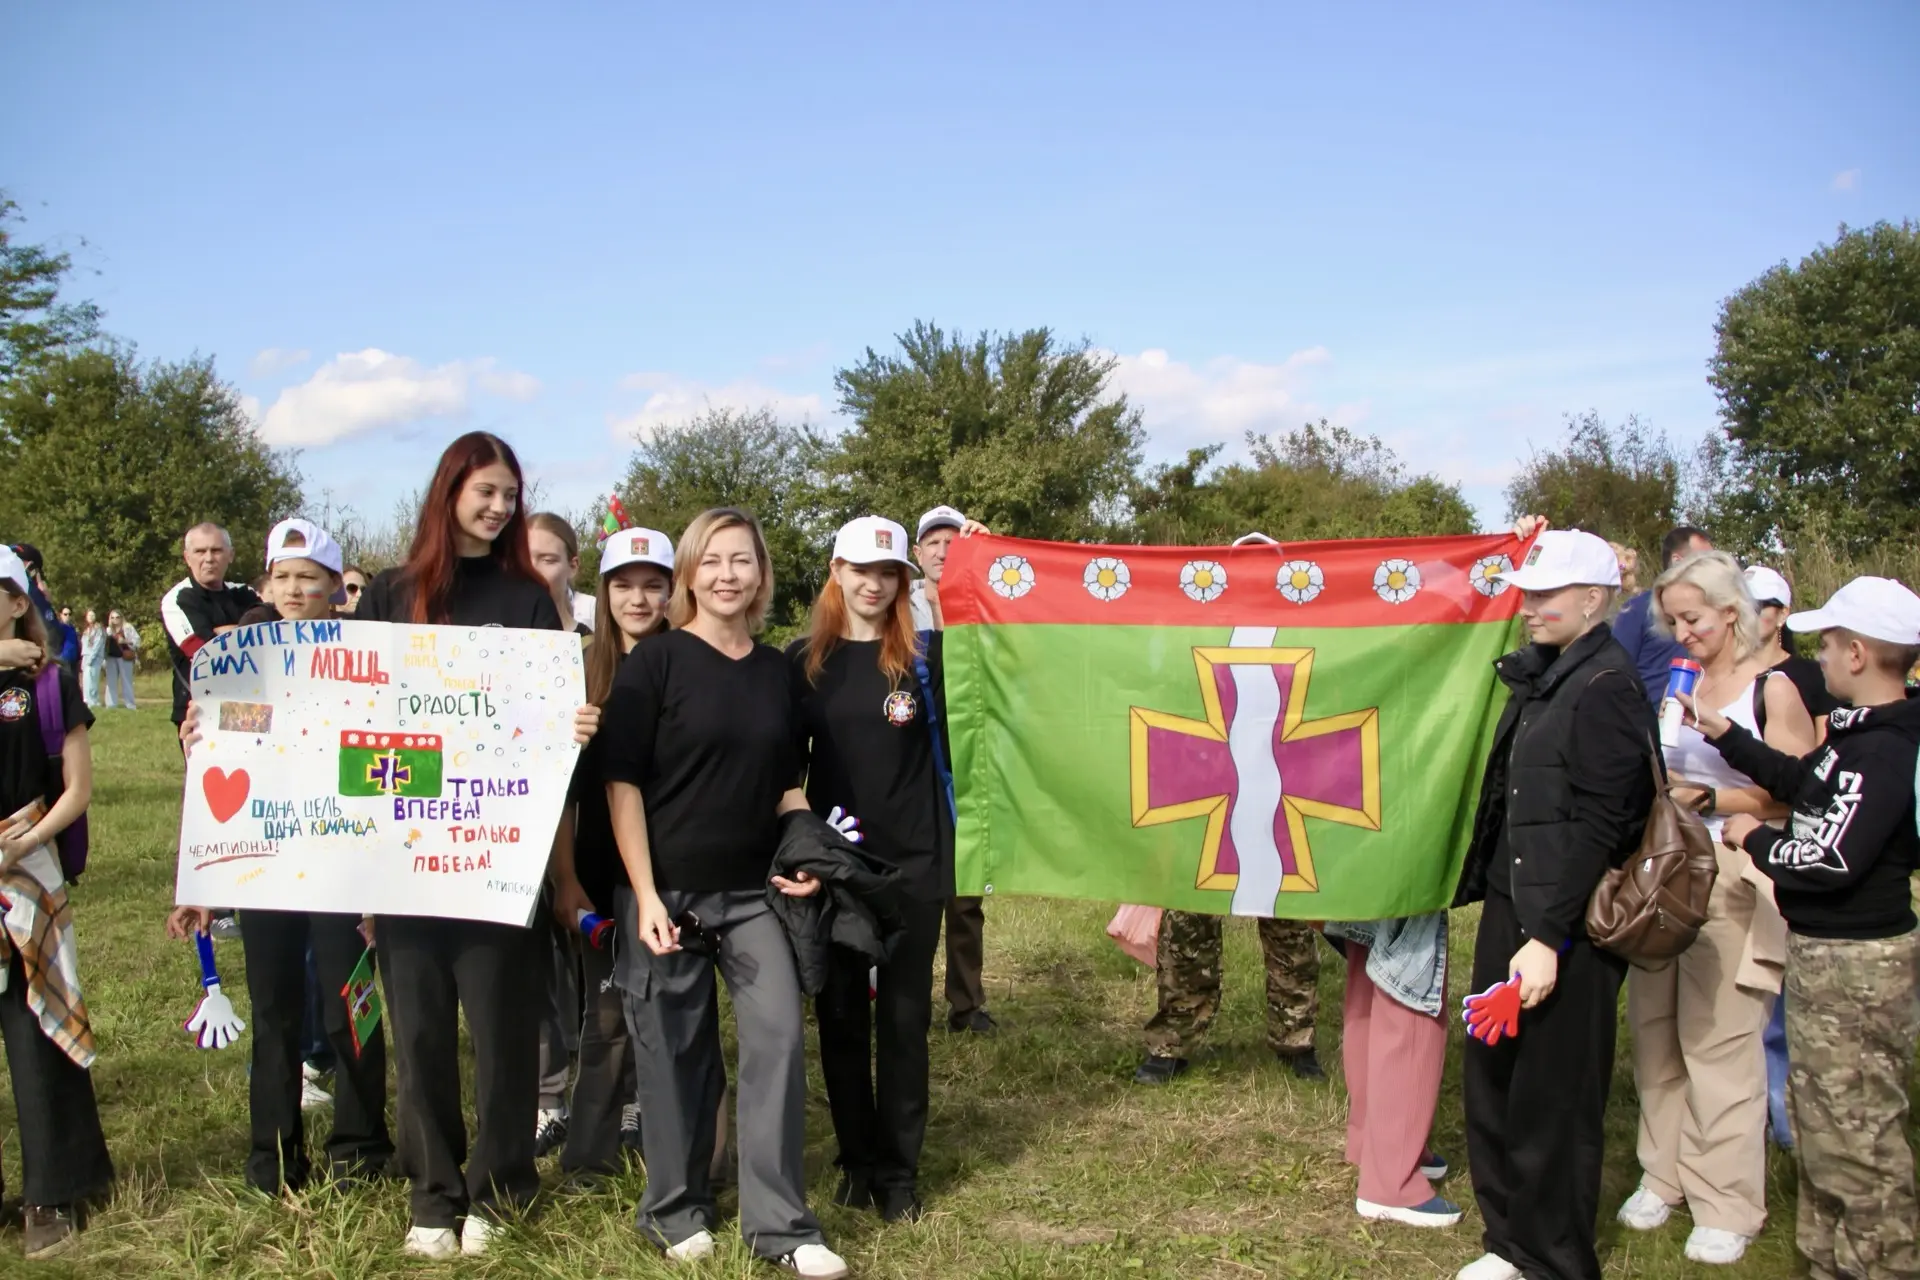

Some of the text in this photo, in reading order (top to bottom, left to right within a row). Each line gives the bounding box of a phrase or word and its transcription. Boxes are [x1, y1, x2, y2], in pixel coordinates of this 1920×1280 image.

[193, 646, 390, 686] СИЛА И МОЩЬ
[398, 691, 497, 718] ГОРДОСТЬ
[447, 777, 530, 798] ТОЛЬКО
[251, 795, 342, 820] ОДНА ЦЕЛЬ
[393, 797, 481, 821] ВПЕРЁД!
[264, 816, 378, 841] ОДНА КОМАНДА
[447, 824, 521, 844] ТОЛЬКО
[188, 839, 280, 858] ЧЕМПИОНЫ!
[413, 849, 492, 874] ПОБЕДА!
